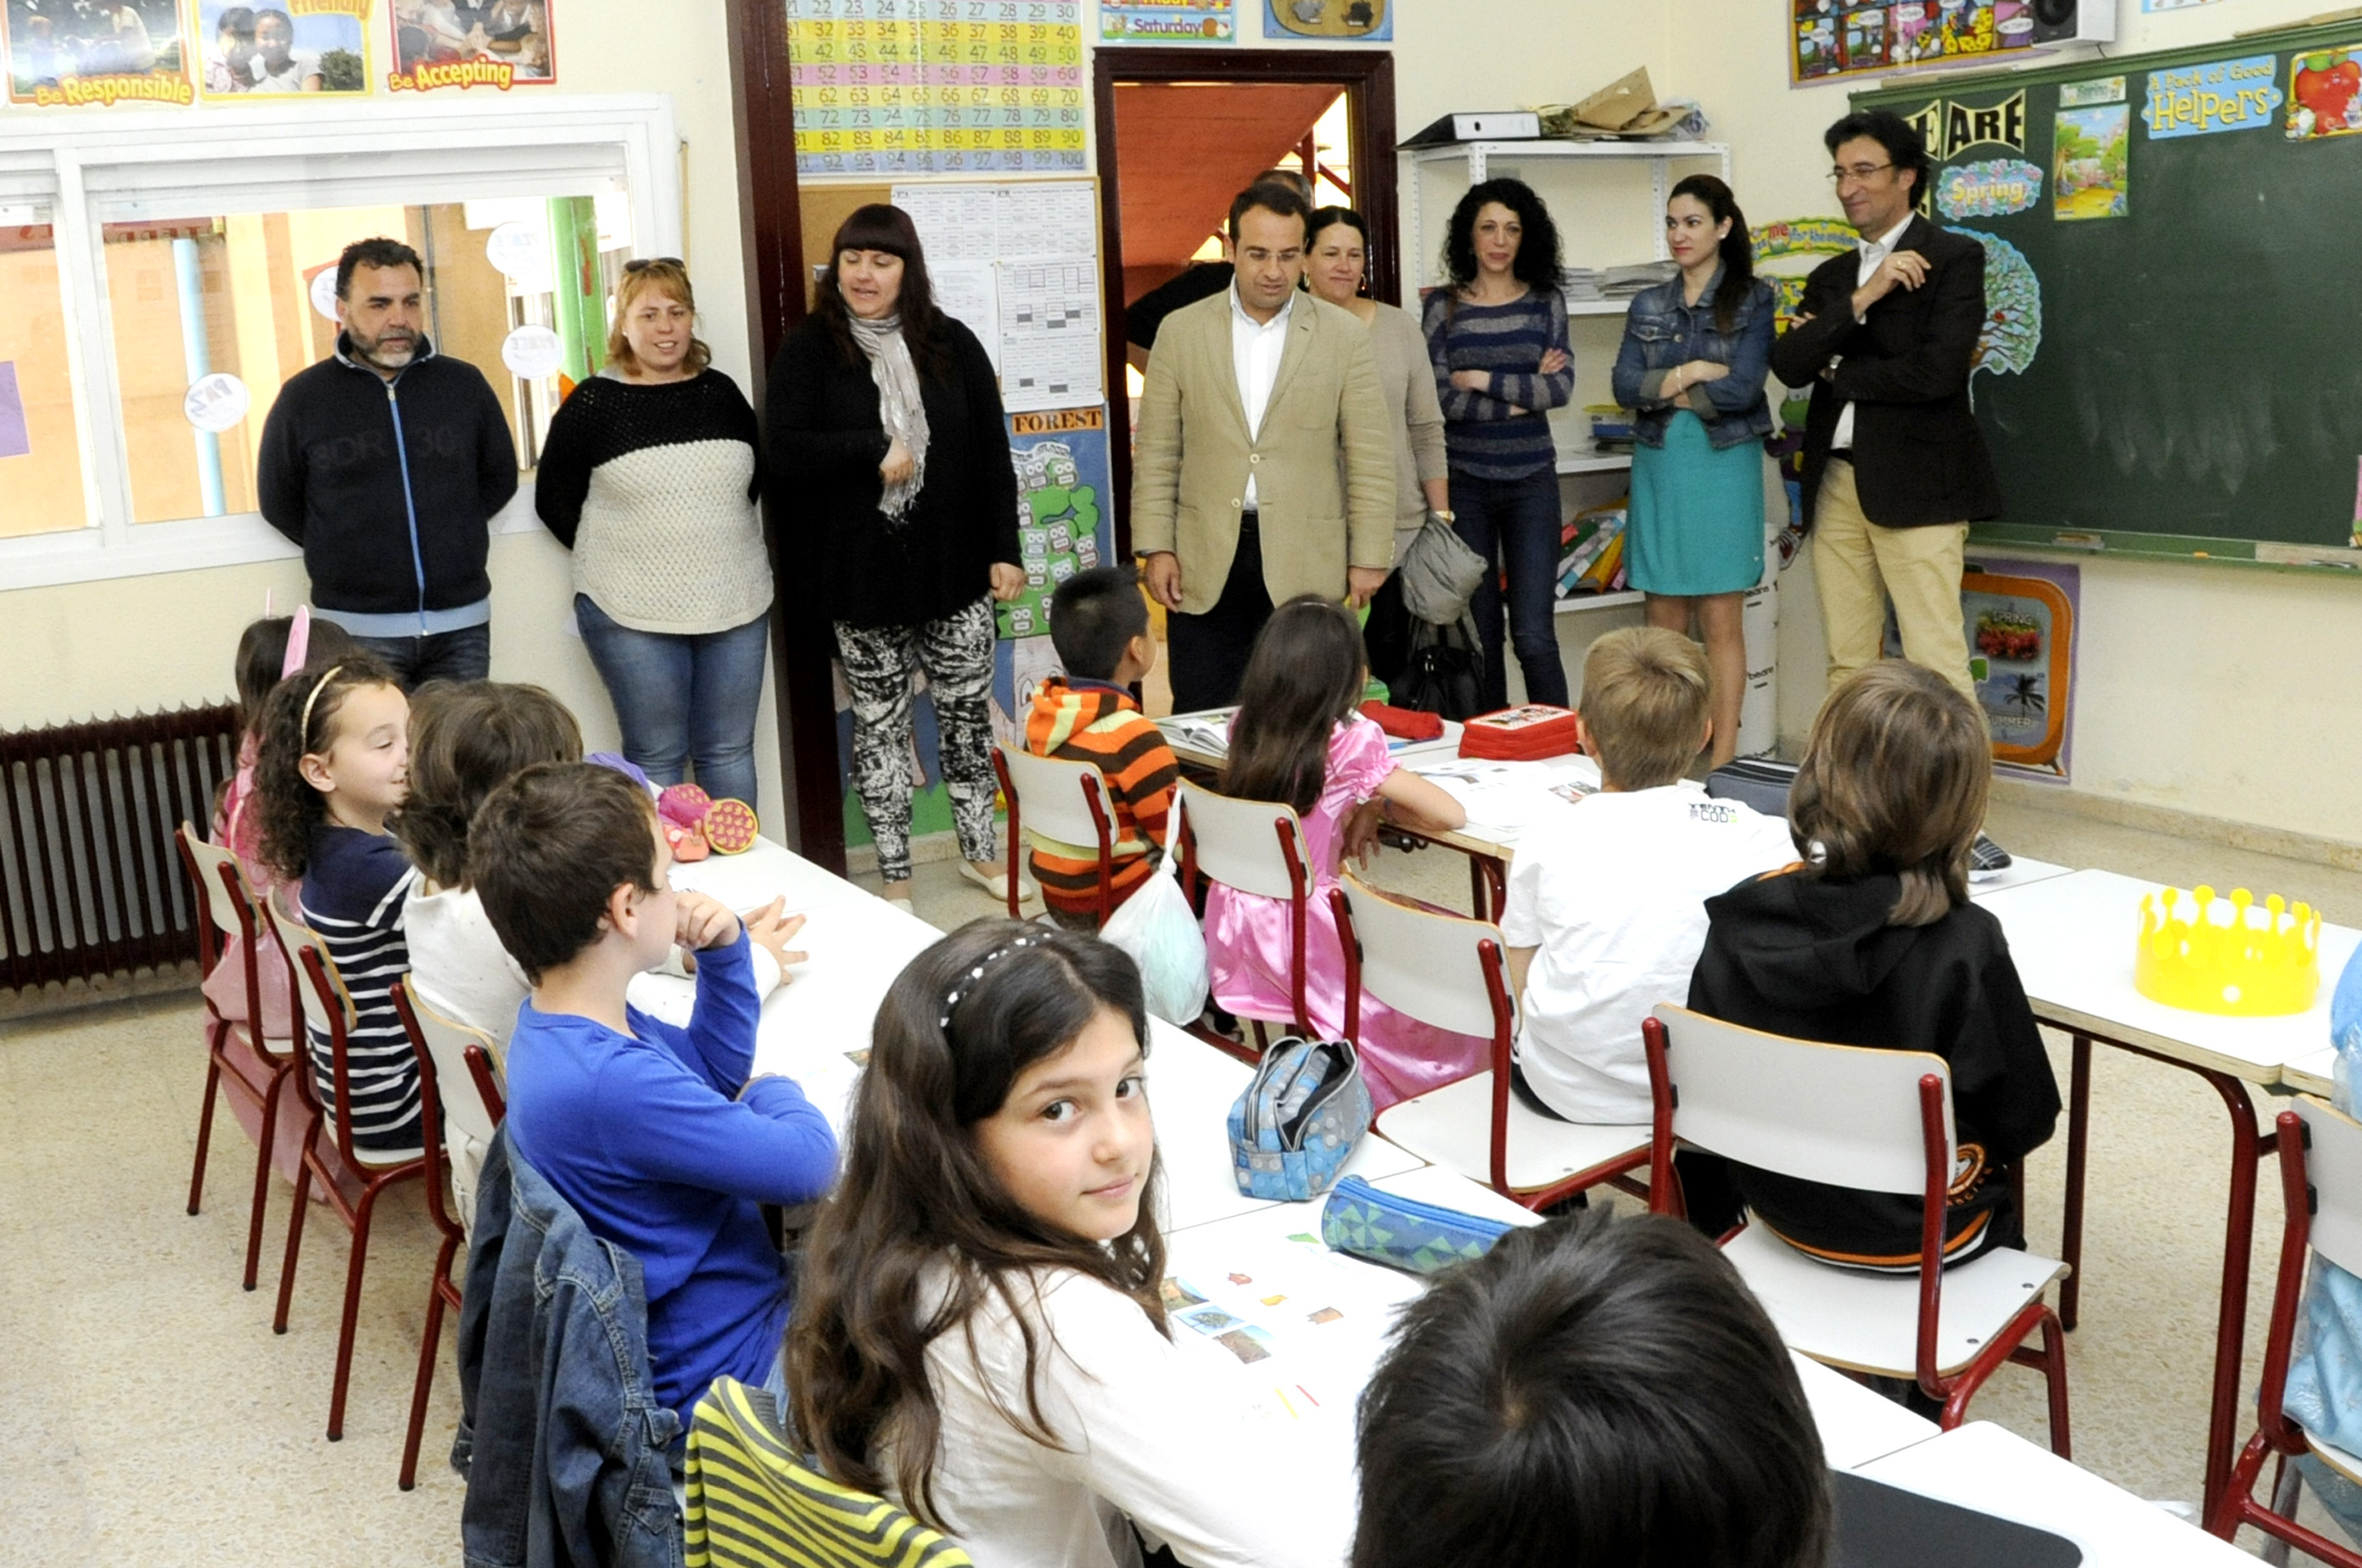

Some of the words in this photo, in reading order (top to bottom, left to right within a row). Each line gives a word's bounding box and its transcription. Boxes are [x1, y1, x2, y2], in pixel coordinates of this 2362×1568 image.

[814, 1, 831, 14] 22
[845, 1, 863, 14] 23
[877, 1, 895, 14] 24
[909, 1, 926, 14] 25
[940, 3, 957, 15] 26
[969, 3, 985, 15] 27
[1000, 3, 1016, 17] 28
[1029, 4, 1046, 17] 29
[1057, 5, 1074, 18] 30
[815, 22, 833, 36] 32
[848, 22, 865, 36] 33
[877, 22, 897, 36] 34
[910, 22, 928, 36] 35
[941, 24, 959, 37] 36
[970, 25, 986, 38] 37
[1000, 25, 1017, 38] 38
[1029, 25, 1046, 39] 39
[1057, 26, 1075, 39] 40
[1134, 17, 1201, 38] Saturday
[816, 45, 833, 58] 42
[848, 43, 866, 58] 43
[879, 45, 898, 58] 44
[910, 44, 928, 58] 45
[939, 46, 957, 59] 46
[971, 46, 988, 59] 47
[999, 47, 1017, 59] 48
[1029, 47, 1046, 59] 49
[1058, 47, 1076, 60] 50
[389, 73, 413, 89] Be
[417, 57, 512, 89] Accepting
[819, 65, 836, 79] 52
[850, 65, 867, 79] 53
[882, 65, 899, 79] 54
[912, 65, 929, 79] 55
[941, 66, 959, 80] 56
[971, 66, 988, 79] 57
[1001, 67, 1019, 80] 58
[1031, 67, 1047, 80] 59
[1058, 67, 1077, 81] 60
[2149, 76, 2160, 91] A
[2165, 70, 2202, 90] Pack
[2208, 62, 2225, 84] of
[2230, 58, 2275, 81] Good
[36, 87, 62, 103] Be
[62, 74, 192, 103] Responsible
[820, 87, 837, 103] 62
[850, 87, 869, 102] 63
[882, 87, 901, 102] 64
[912, 87, 930, 101] 65
[941, 88, 960, 102] 66
[971, 88, 988, 102] 67
[1001, 88, 1020, 102] 68
[1031, 89, 1049, 102] 69
[1061, 89, 1077, 103] 70
[820, 110, 839, 123] 72
[853, 109, 870, 123] 73
[884, 109, 902, 122] 74
[914, 109, 932, 122] 75
[943, 109, 960, 122] 76
[973, 109, 991, 122] 77
[1005, 109, 1021, 122] 78
[1033, 109, 1049, 121] 79
[1061, 109, 1078, 122] 80
[2152, 87, 2270, 131] Helpers
[1948, 94, 2024, 159] ARE
[821, 132, 840, 145] 82
[854, 132, 872, 144] 83
[885, 131, 904, 143] 84
[915, 131, 932, 143] 85
[943, 131, 962, 143] 86
[974, 131, 991, 143] 87
[1004, 131, 1021, 143] 88
[1033, 131, 1050, 143] 89
[1062, 131, 1080, 143] 90
[823, 155, 843, 166] 92
[887, 152, 905, 165] 94
[944, 153, 963, 165] 96
[976, 153, 991, 165] 97
[1004, 152, 1021, 165] 98
[1034, 152, 1052, 164] 99
[1061, 152, 1083, 165] 100
[1951, 177, 2024, 205] Spring
[1014, 410, 1101, 433] FOREST
[1993, 610, 2032, 625] SPRING
[1990, 715, 2031, 728] UMMER
